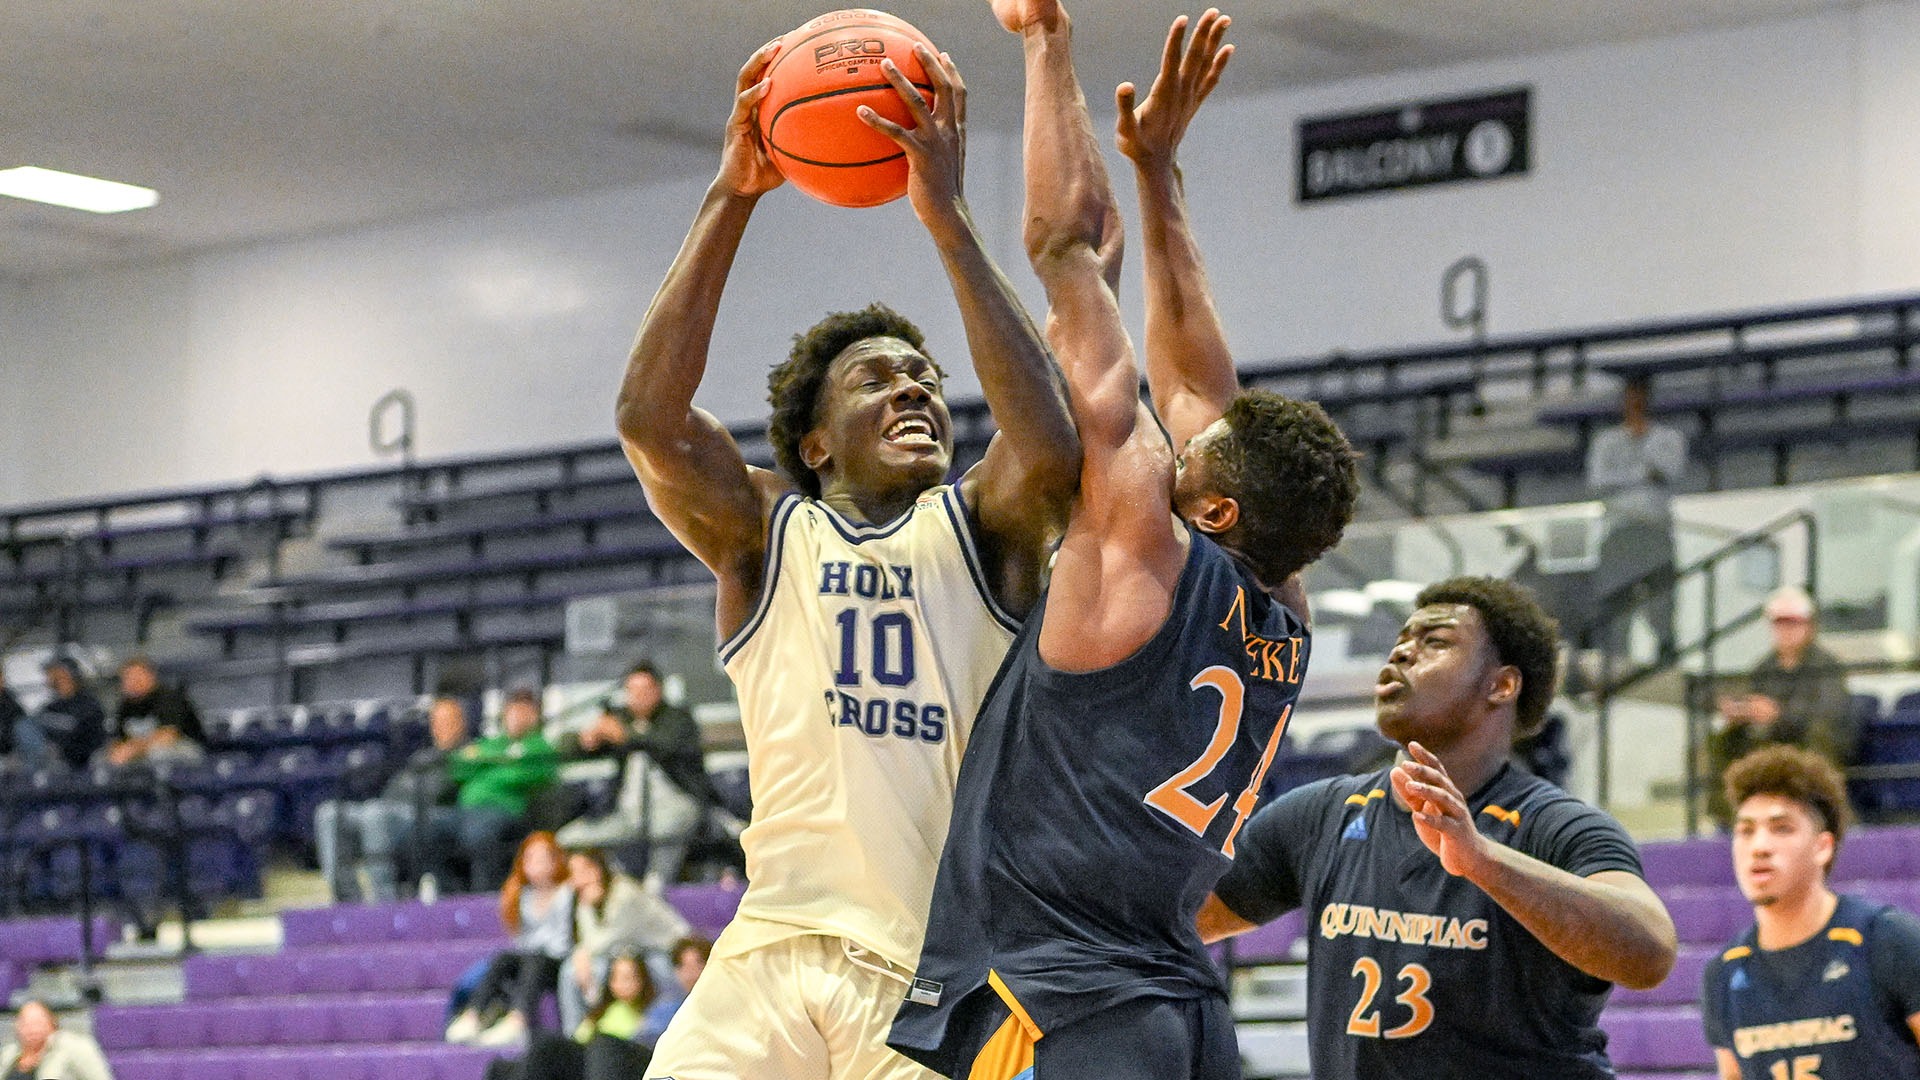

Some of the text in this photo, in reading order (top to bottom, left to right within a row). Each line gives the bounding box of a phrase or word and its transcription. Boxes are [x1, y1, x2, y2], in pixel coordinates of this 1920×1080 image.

[815, 39, 885, 63] PRO
[819, 561, 914, 602] HOLY
[834, 607, 917, 689] 10
[1320, 902, 1489, 950] QUINNIPIAC
[1346, 956, 1435, 1040] 23
